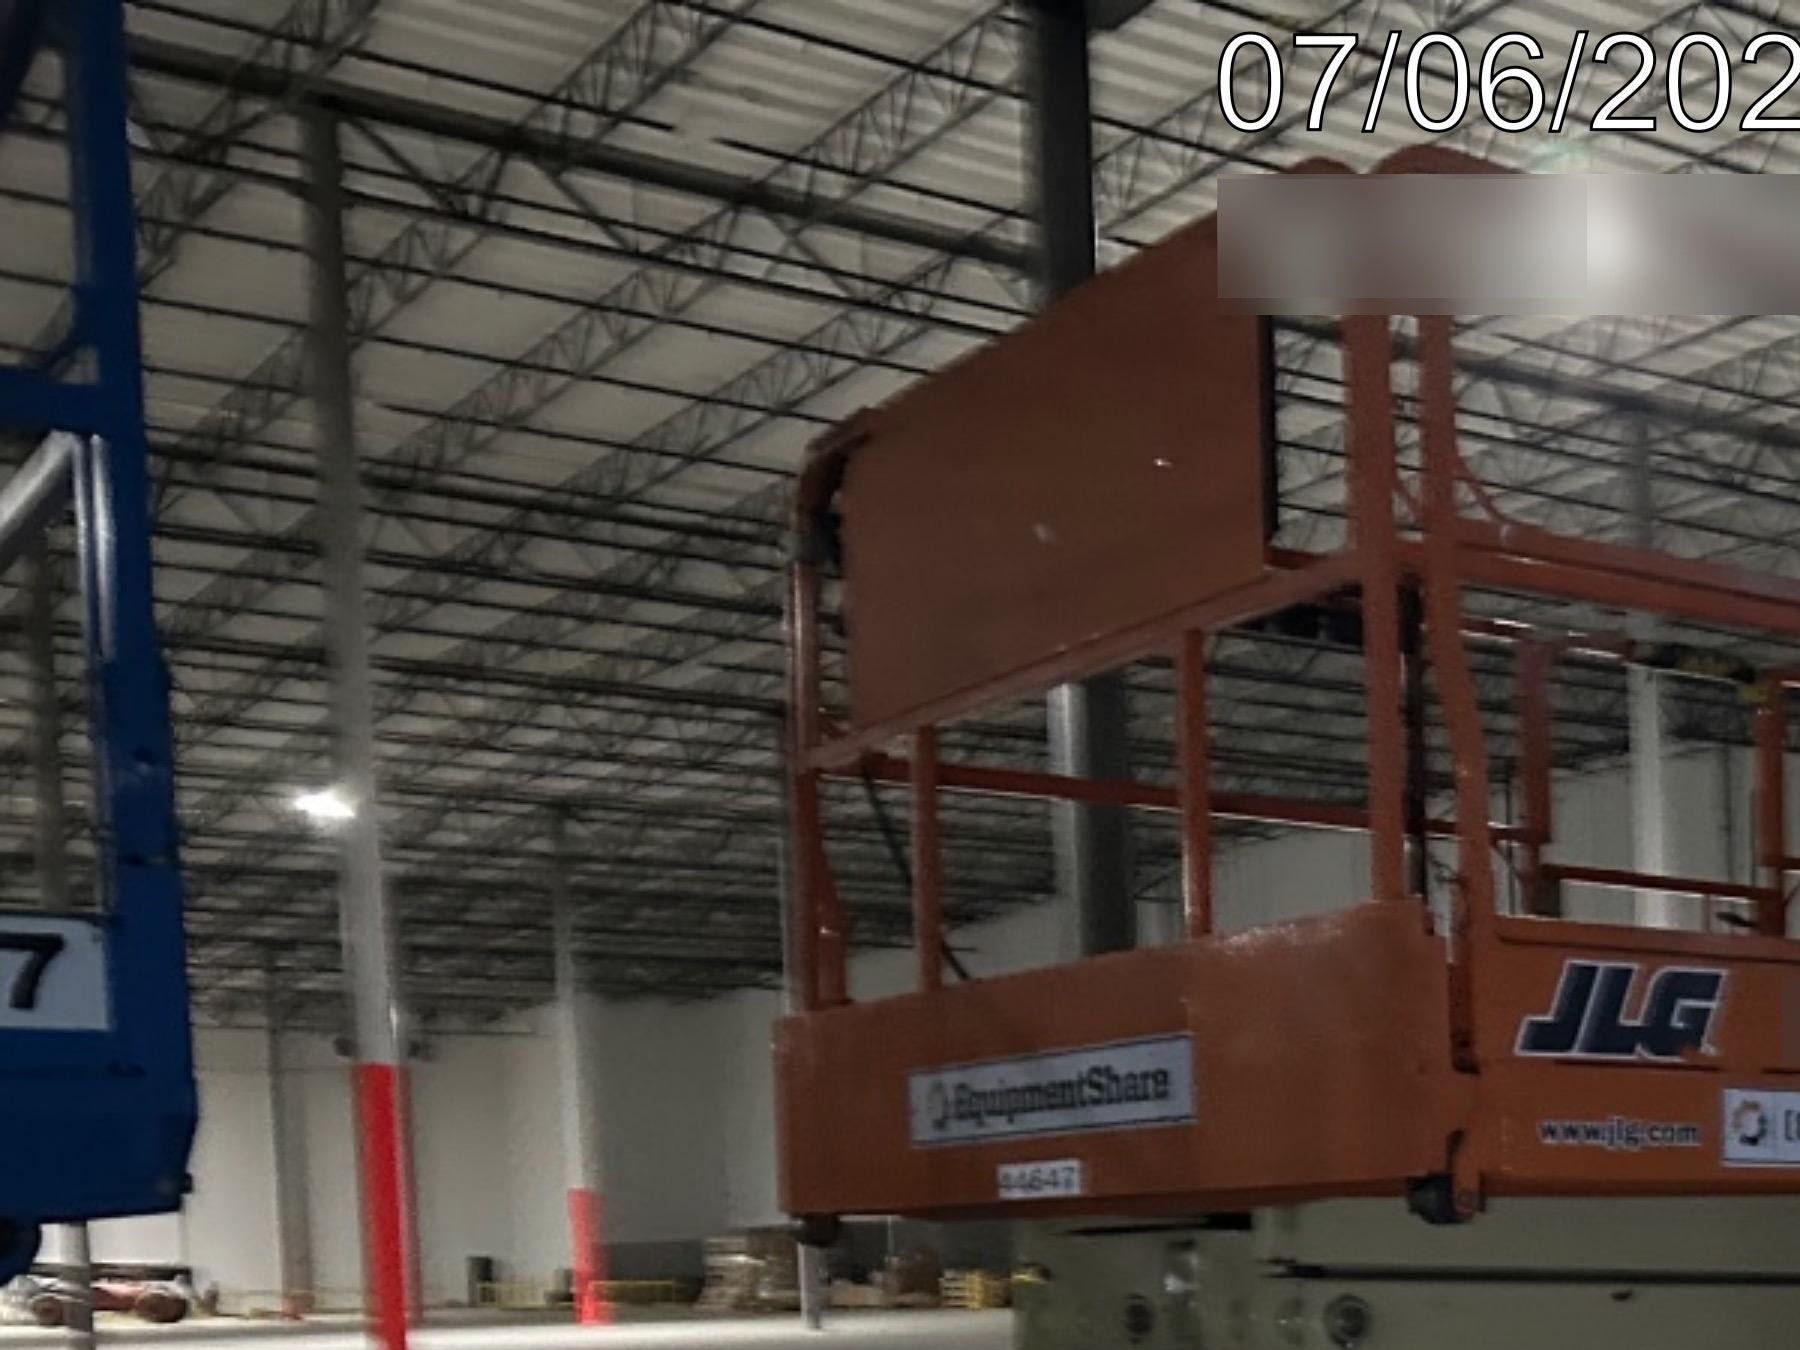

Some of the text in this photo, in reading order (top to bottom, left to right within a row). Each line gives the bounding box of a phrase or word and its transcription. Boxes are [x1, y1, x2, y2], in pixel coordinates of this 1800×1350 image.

[1514, 958, 1729, 1062] JLG
[953, 1065, 1170, 1127] EquipmentShare
[1538, 1116, 1700, 1150] www.jlg.com
